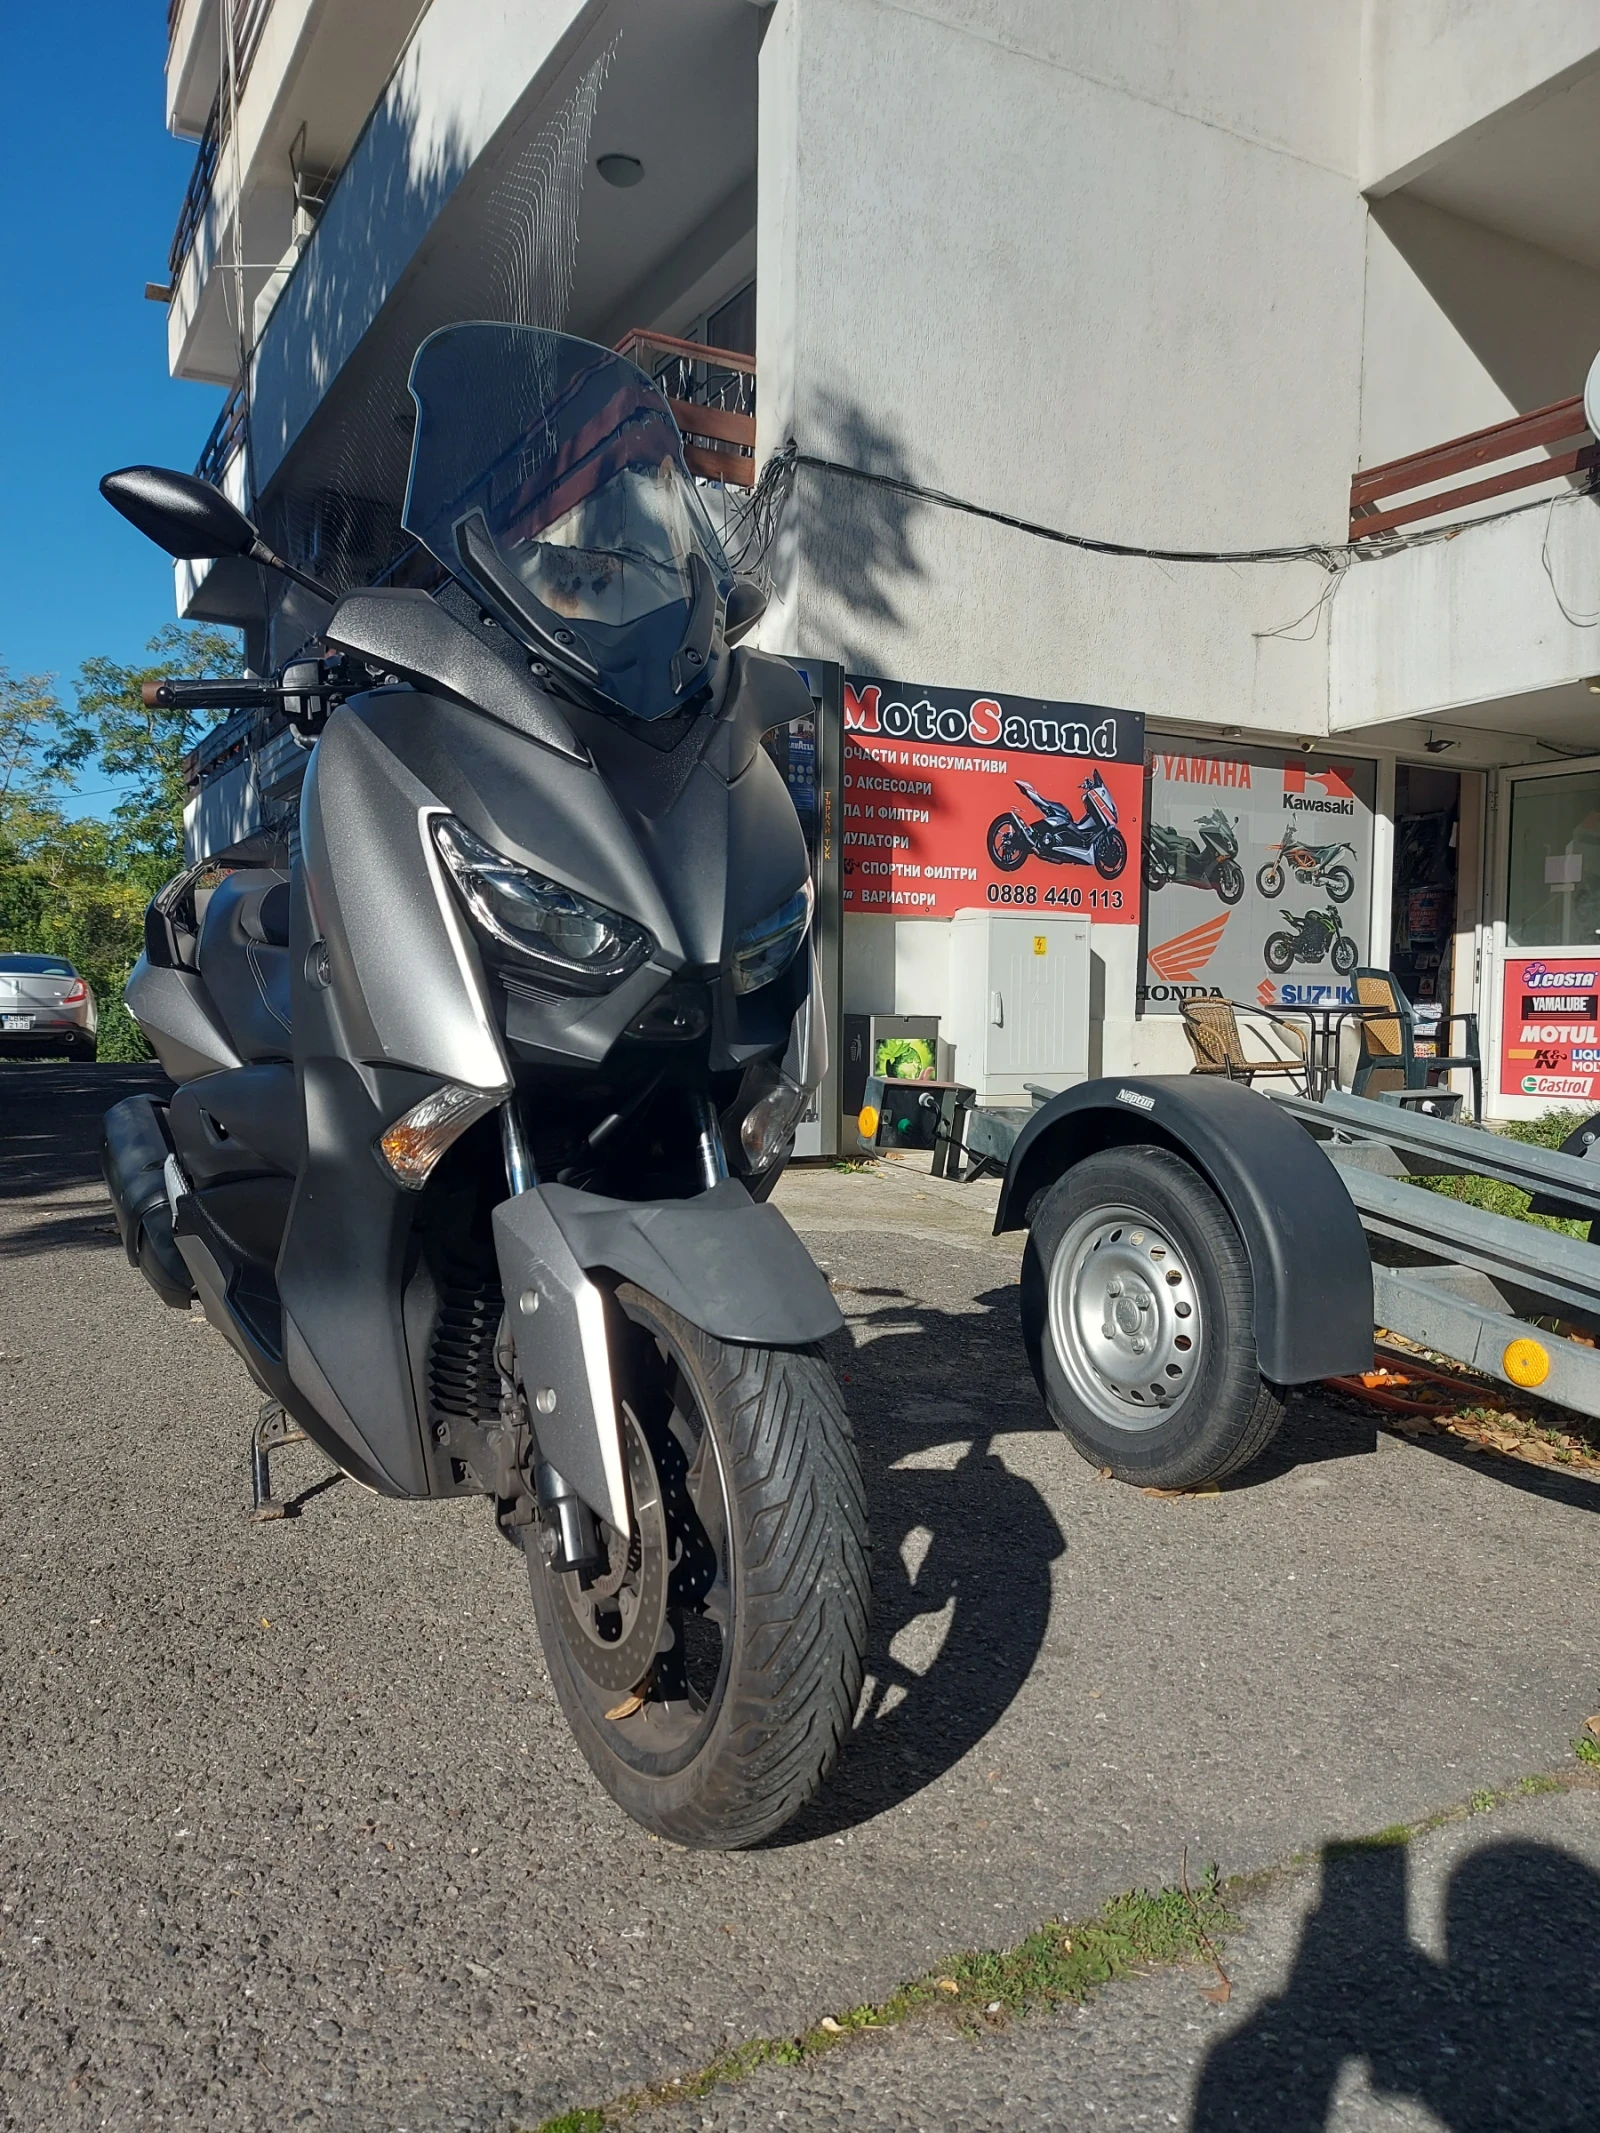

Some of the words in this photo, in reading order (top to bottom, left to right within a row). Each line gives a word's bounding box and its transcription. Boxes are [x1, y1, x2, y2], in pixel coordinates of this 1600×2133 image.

[844, 683, 1117, 758] MotoSaund
[844, 746, 898, 764] ОЧАСТИ
[900, 751, 910, 766] И
[912, 753, 1008, 774] КОНСУМАТИВИ
[1163, 751, 1252, 789] YAMAHA
[844, 774, 853, 788] О
[857, 775, 932, 796] АКСЕСОАРИ
[844, 803, 861, 818] ЛА
[865, 805, 874, 819] И
[878, 806, 930, 823] ФИЛТРИ
[1282, 793, 1354, 815] Kawasaki
[844, 831, 909, 850] МУЛАТОРИ
[861, 861, 921, 878] СПОРТНИ
[924, 865, 978, 881] ФИЛТРИ
[861, 889, 936, 906] ВАРИАТОРИ
[987, 883, 1038, 905] 0888
[1043, 885, 1082, 907] 440
[1088, 889, 1124, 909] 113
[1528, 972, 1595, 988] J.COSTA
[1136, 985, 1224, 1002] HONDA
[1281, 984, 1353, 1005] SUZUK
[1532, 996, 1588, 1012] YAMALUBE
[1520, 1025, 1598, 1044] MOTUL
[1571, 1049, 1600, 1061] LIQU
[1538, 1078, 1587, 1094] Castrol
[1116, 1088, 1156, 1110] Neptun
